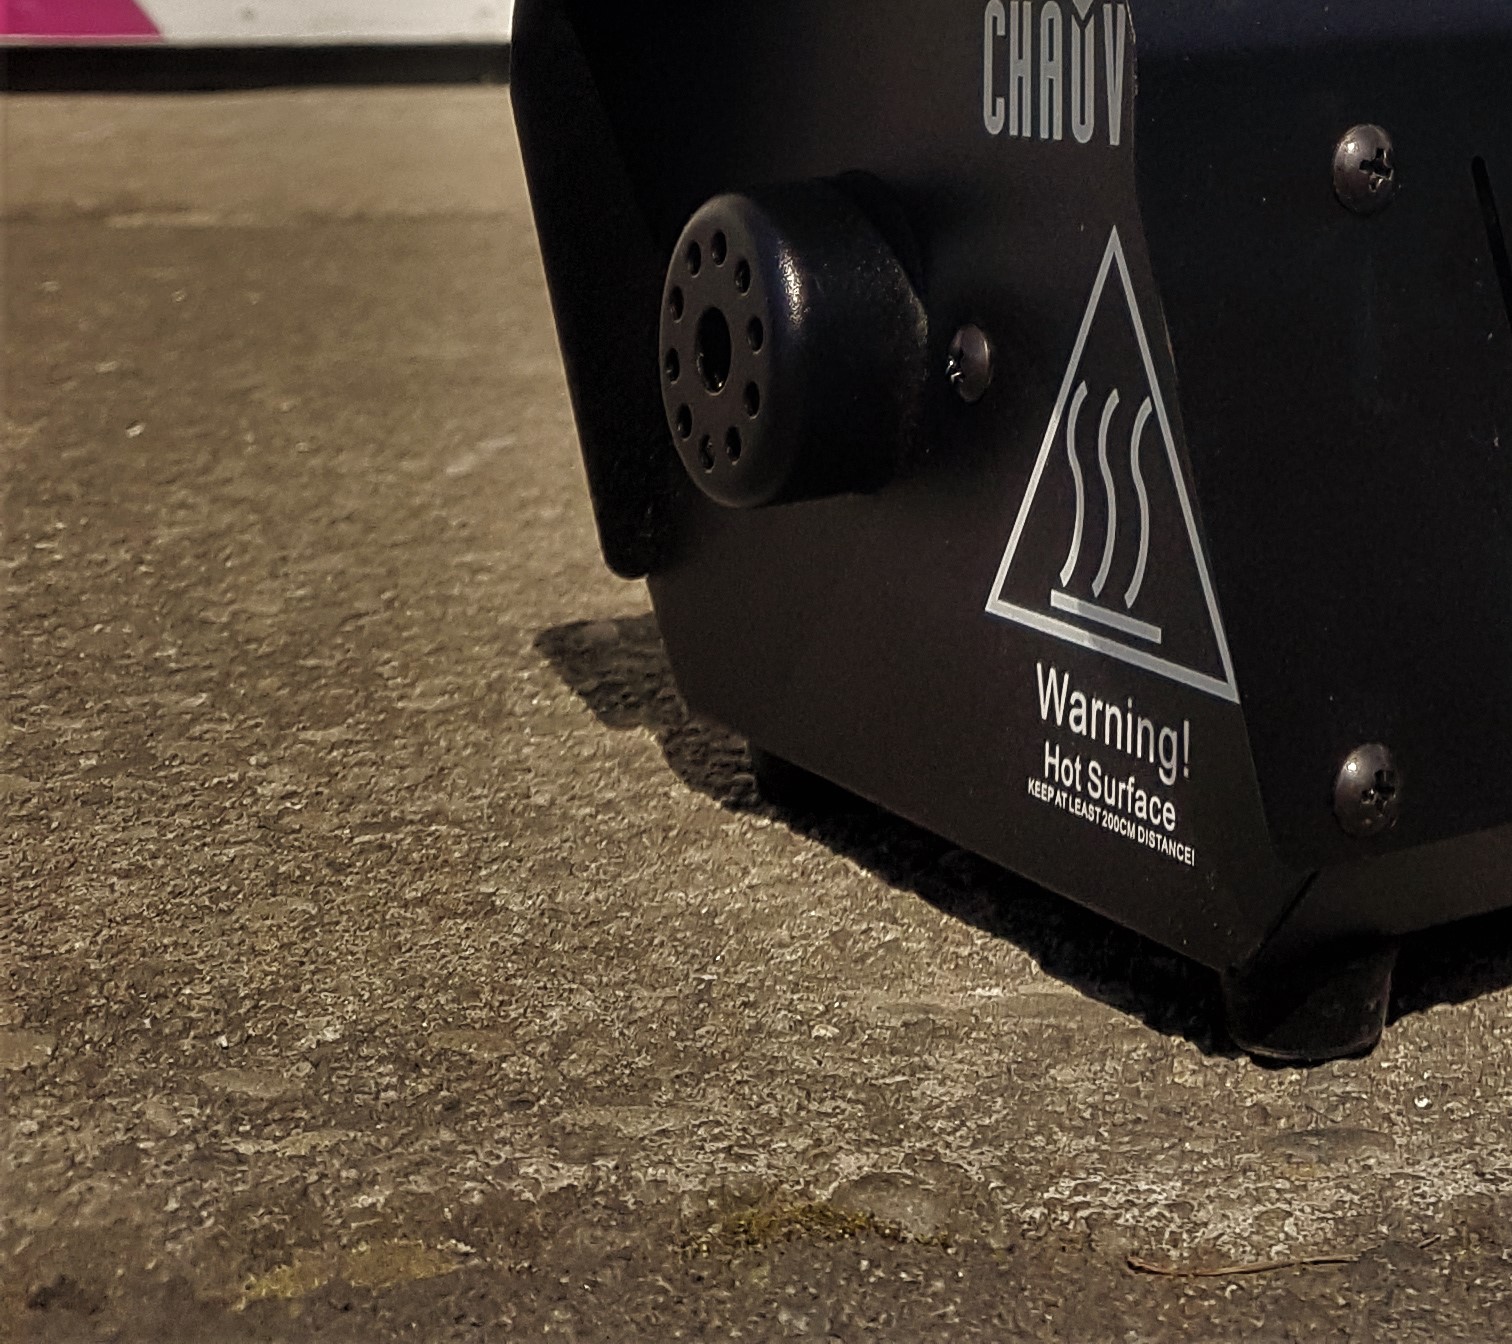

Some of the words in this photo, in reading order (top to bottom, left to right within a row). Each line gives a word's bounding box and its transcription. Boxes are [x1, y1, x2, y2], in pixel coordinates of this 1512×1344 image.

[1036, 661, 1190, 786] Warning!
[1027, 777, 1054, 803] KEEP
[1055, 789, 1068, 810] AT
[1068, 795, 1101, 824] LEAST
[1102, 809, 1136, 840] 200CM
[1044, 740, 1082, 792] Hot
[1087, 760, 1176, 832] Surface
